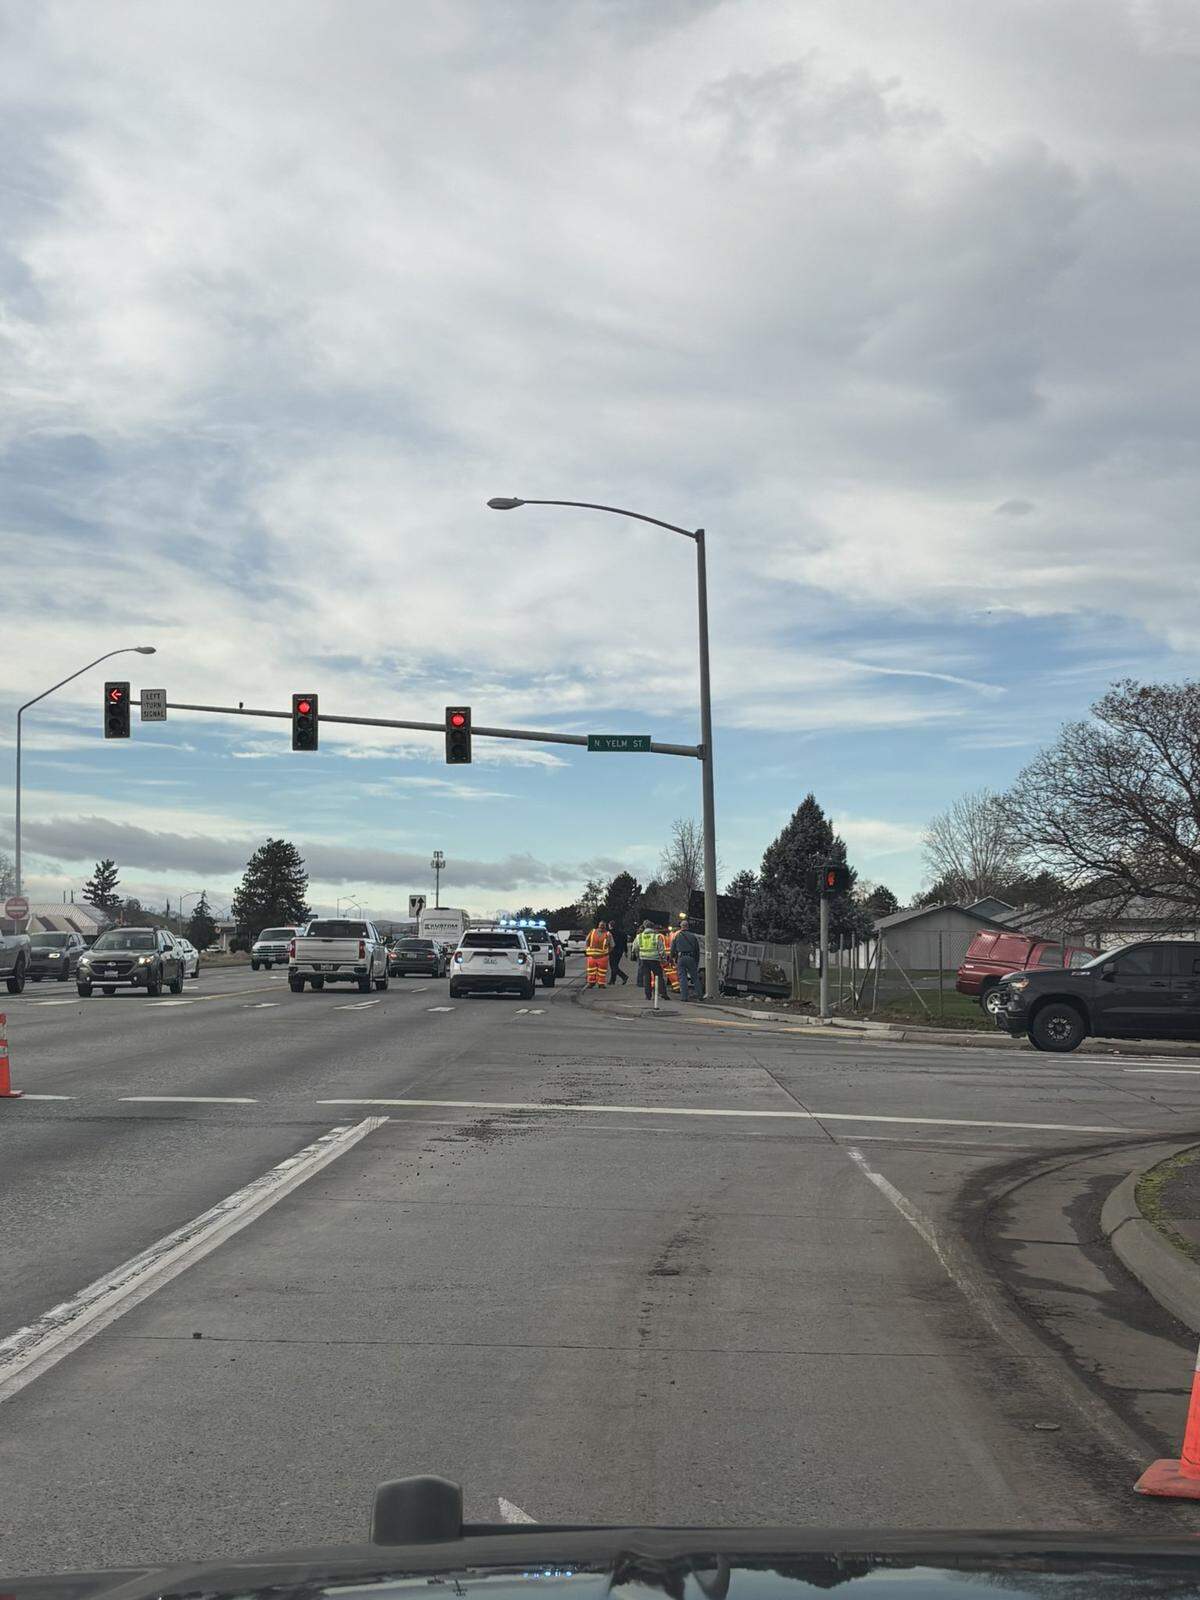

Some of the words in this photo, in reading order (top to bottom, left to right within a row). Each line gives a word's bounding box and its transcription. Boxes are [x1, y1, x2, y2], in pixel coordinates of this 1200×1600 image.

[594, 739, 600, 747] N
[606, 739, 628, 748] YELM
[633, 739, 643, 748] ST
